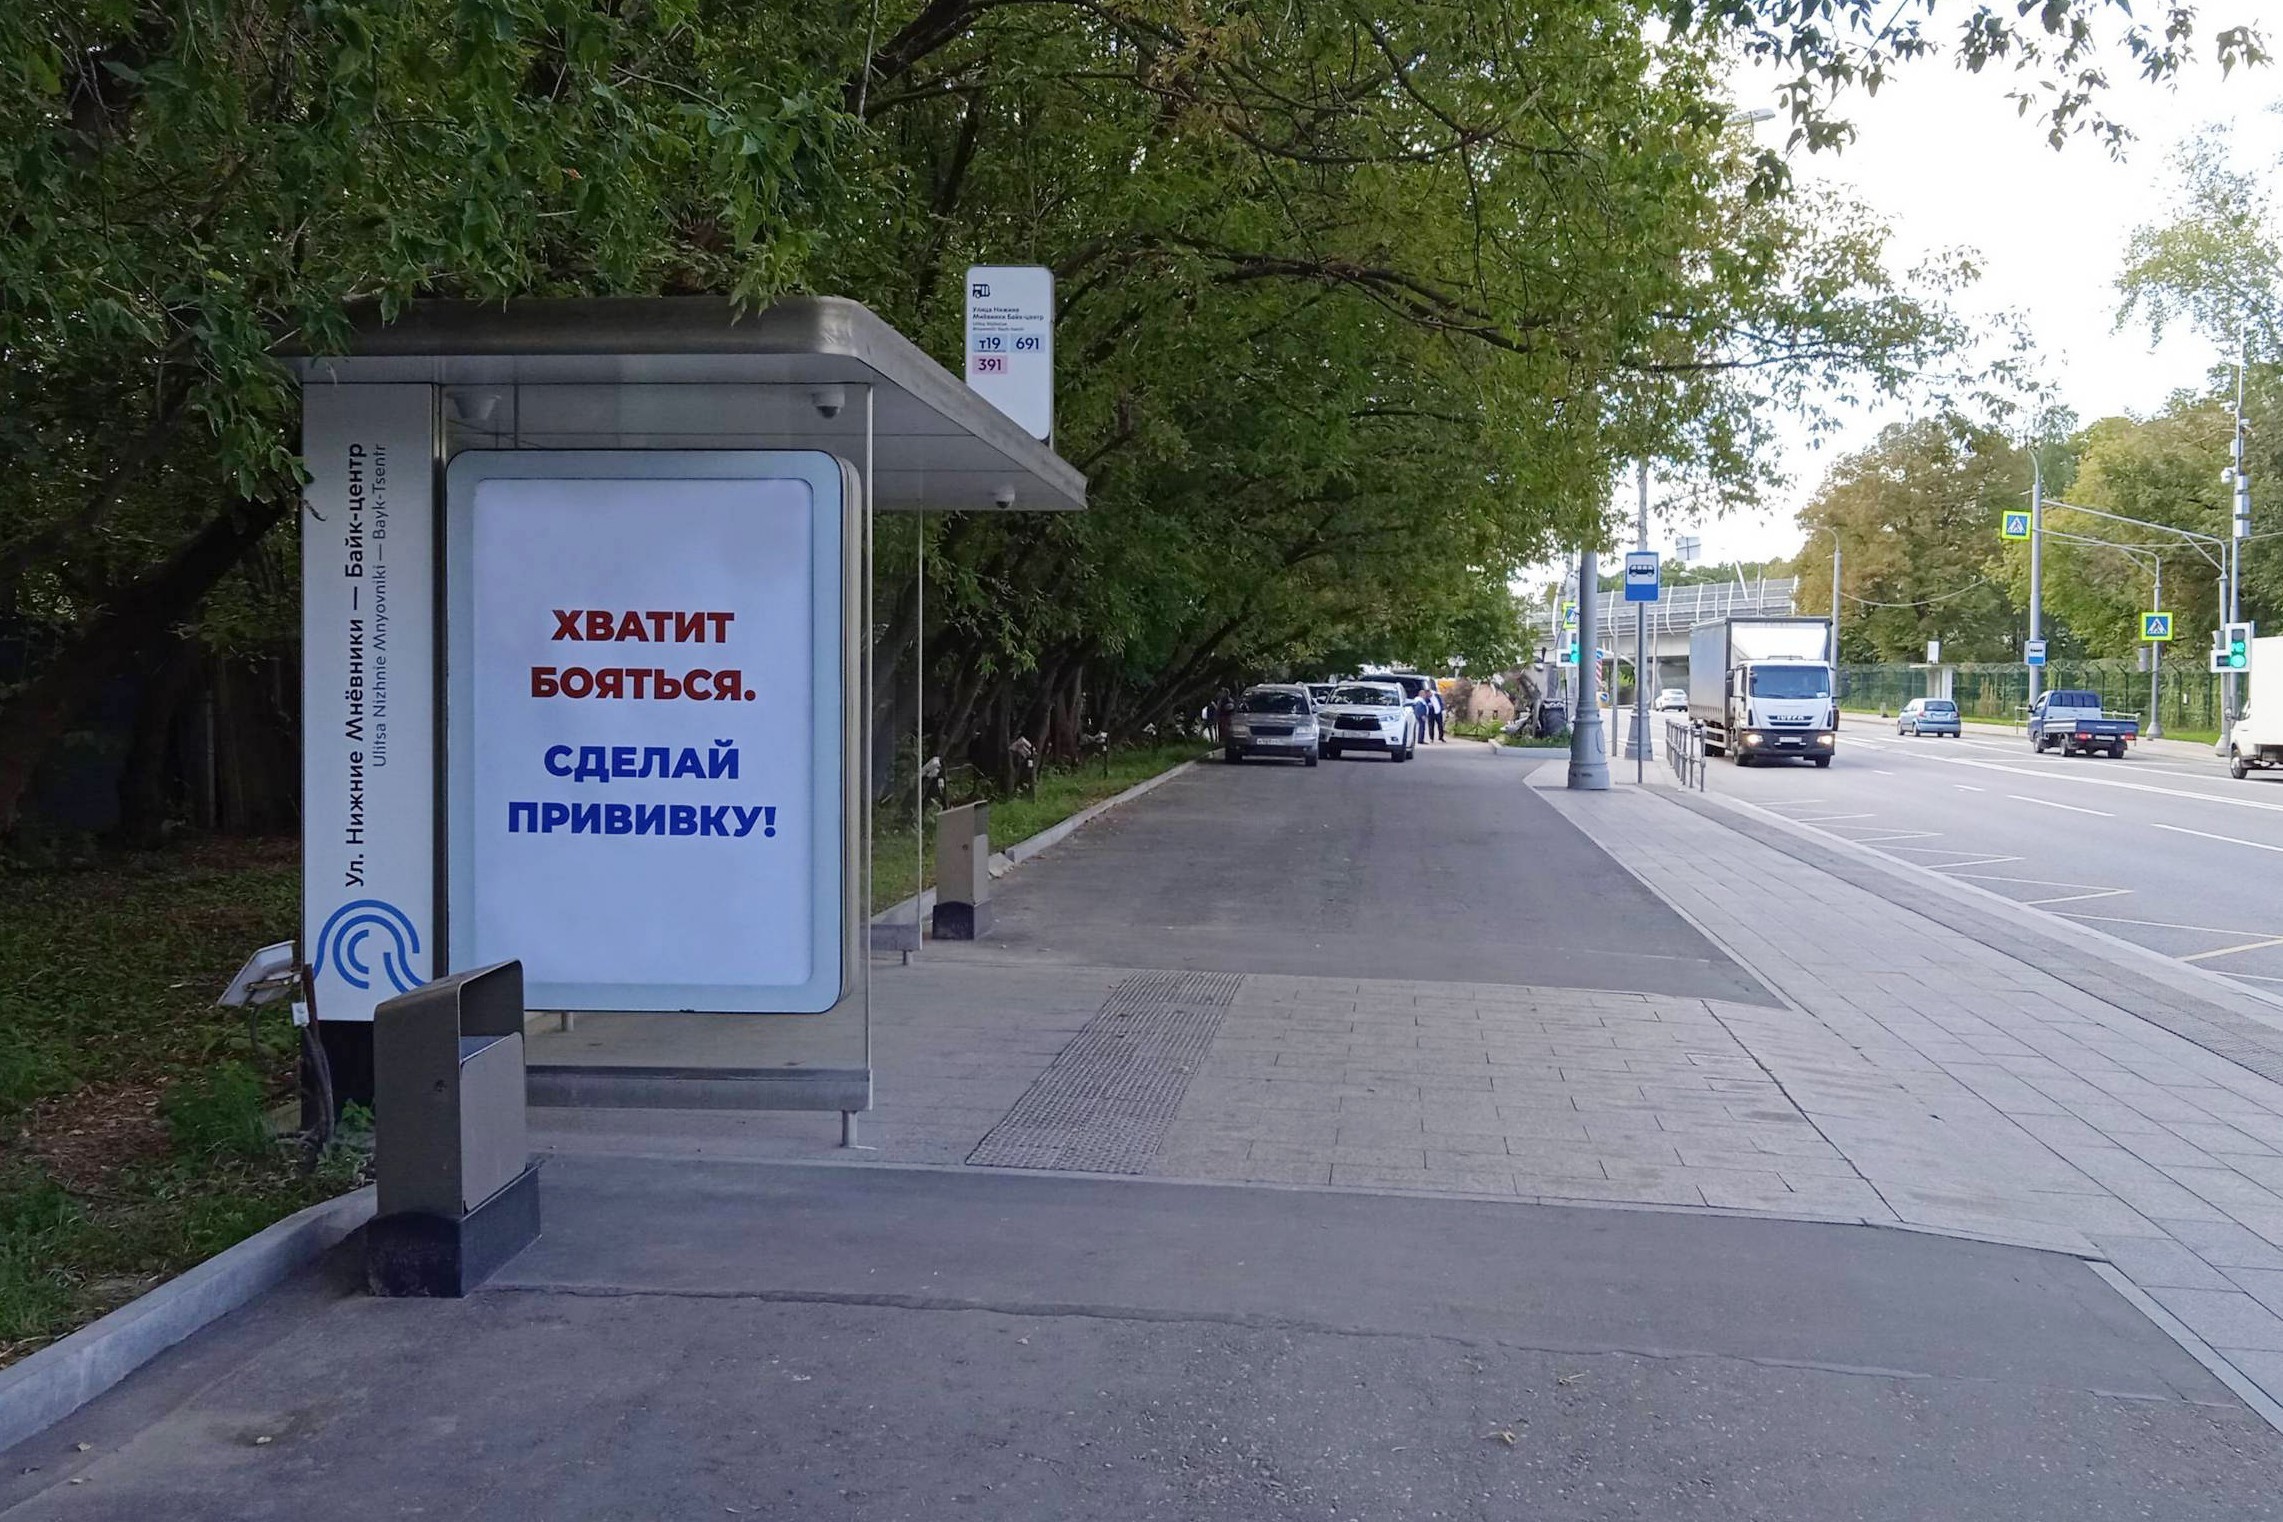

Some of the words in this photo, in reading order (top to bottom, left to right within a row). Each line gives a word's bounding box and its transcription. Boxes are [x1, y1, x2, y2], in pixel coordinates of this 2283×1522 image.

[978, 358, 1002, 371] 391
[1016, 337, 1039, 350] 691
[345, 443, 367, 577] Байк-центр
[372, 443, 389, 539] Bayk-Tsentr
[372, 565, 389, 651] Mnyovniki
[551, 609, 735, 643] ХВАТИТ
[345, 619, 364, 741] Мнёвники
[372, 655, 387, 717] Nizhnie
[531, 666, 756, 701] БОЯТЬСЯ.
[372, 723, 387, 767] Ulitsa
[544, 739, 739, 783] СДЕЛАЙ
[345, 750, 364, 844] Нижние
[508, 801, 777, 837] ПРИВИВКУ!
[345, 853, 364, 887] Ул.
